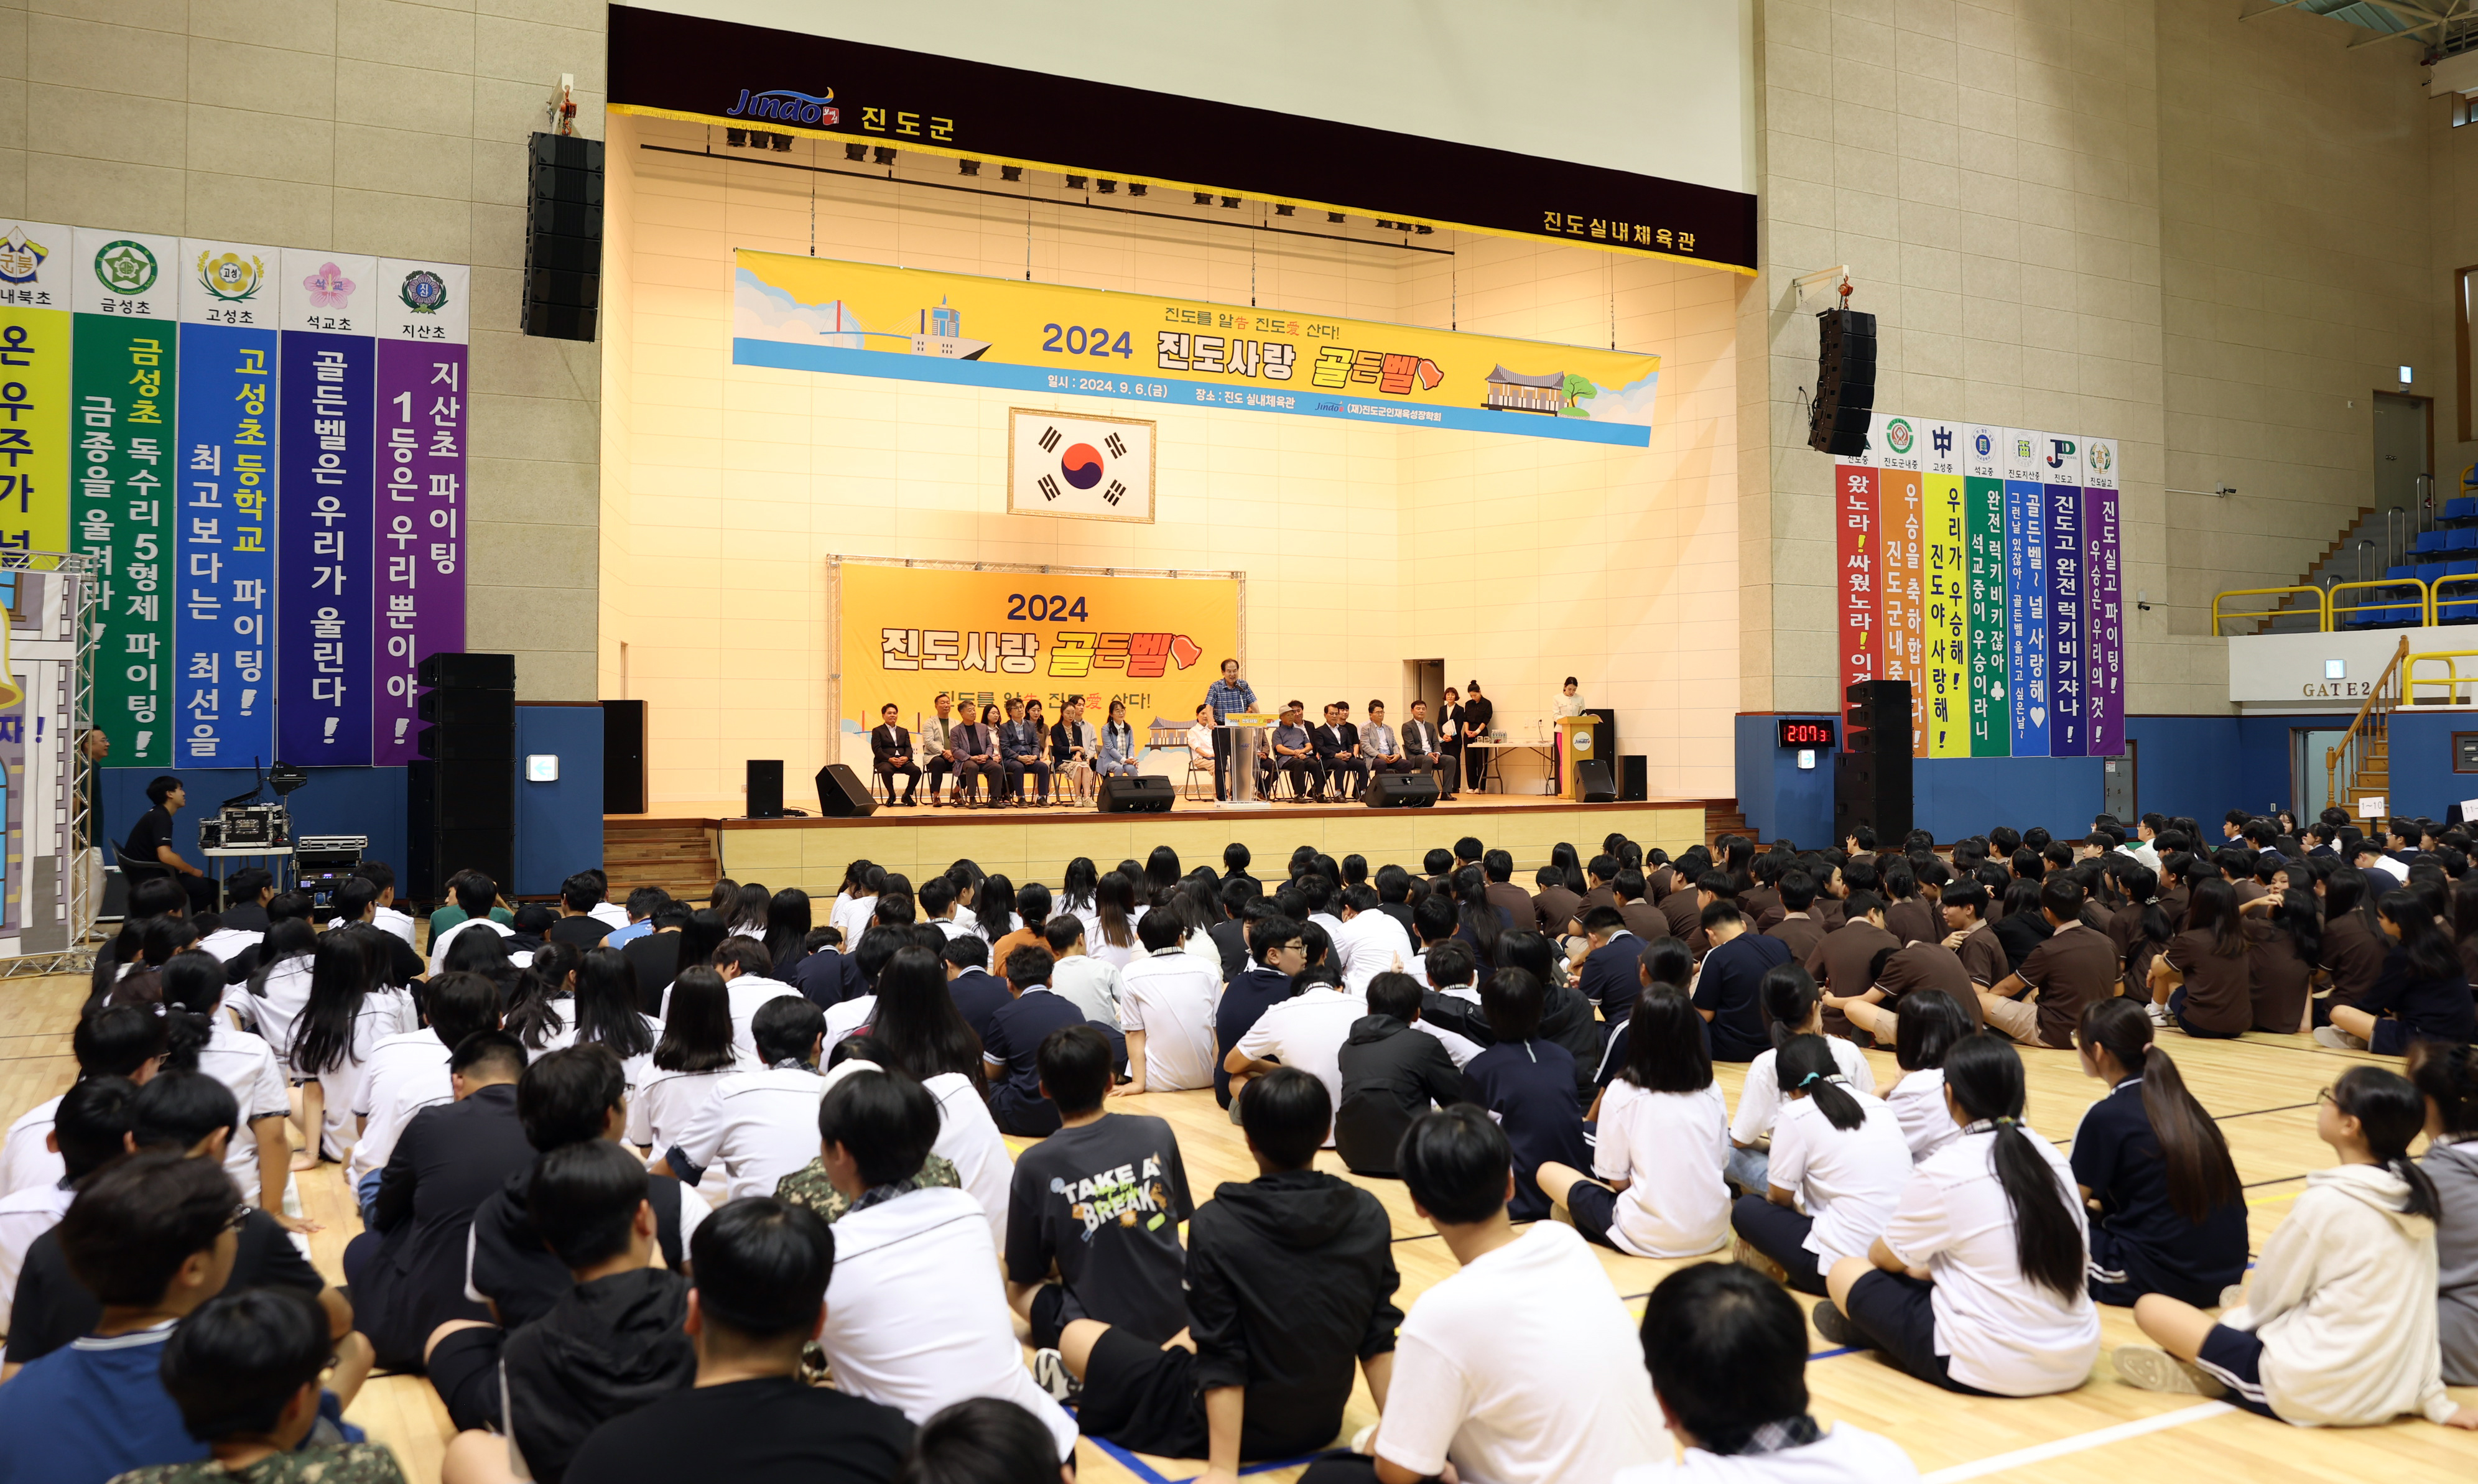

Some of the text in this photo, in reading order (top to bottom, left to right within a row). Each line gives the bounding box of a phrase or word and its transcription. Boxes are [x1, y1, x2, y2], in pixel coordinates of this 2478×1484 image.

[727, 89, 821, 123] Jindo
[861, 107, 954, 141] 진도군
[1544, 211, 1696, 252] 진도실내체육관
[1, 289, 51, 304] 내북초
[101, 299, 151, 314] 금성초
[206, 309, 253, 323] 고성초
[307, 316, 351, 330] 석교초
[403, 325, 445, 338] 지산초
[1165, 307, 1212, 327] 진도를
[1307, 323, 1340, 340] 산다!
[128, 338, 162, 424] 금성초
[1042, 323, 1419, 395] 2024 진도사랑 골든벨
[1047, 374, 1069, 389] 일시
[1079, 378, 1117, 394] 2024.
[1120, 383, 1131, 394] 9.
[1195, 388, 1216, 401] 장소
[1224, 392, 1244, 406] 진도
[1246, 394, 1295, 410] 실내체육관
[312, 351, 348, 485] 골든벨은
[80, 396, 116, 498] 금종을
[387, 392, 418, 501] 1등은
[429, 363, 460, 573] 지산초 파이팅
[1885, 458, 1918, 469] 진도군내중
[1933, 463, 1952, 473] 고성중
[1975, 466, 1993, 476] 석교중
[2009, 470, 2039, 480] 진도지산중
[2055, 475, 2072, 483] 진도고
[2091, 478, 2112, 487] 진도실고
[233, 349, 267, 716] 고성초등학교 파이팅!
[1905, 484, 1920, 568] 우승을
[2054, 496, 2076, 550] 진도고
[312, 496, 346, 595] 우리가
[1947, 488, 1963, 690] 우리가 우승해!
[1987, 491, 2004, 672] 완전 럭키비키잖아
[2056, 559, 2076, 595] 완전
[2090, 540, 2101, 610] 우승은
[2103, 501, 2118, 693] 진도실고 파이팅!
[187, 445, 223, 756] 최고보다는 최선을
[1008, 594, 1088, 622] 2024
[2013, 594, 2023, 636] 골든벨
[2029, 595, 2043, 619] 널
[882, 628, 1173, 677] 진도사랑 골든벨
[1931, 545, 1947, 748] 진도야 사랑해!
[1972, 534, 1987, 740] 석교중이 우승이라니
[2092, 619, 2102, 687] 우리의
[2014, 641, 2023, 681] 울리고
[2028, 628, 2044, 703] 사랑해
[126, 633, 160, 758] 파이팅!
[2362, 801, 2382, 810] 1~10
[1060, 1158, 1161, 1204] TAKE A
[1079, 1180, 1157, 1232] BREAK
